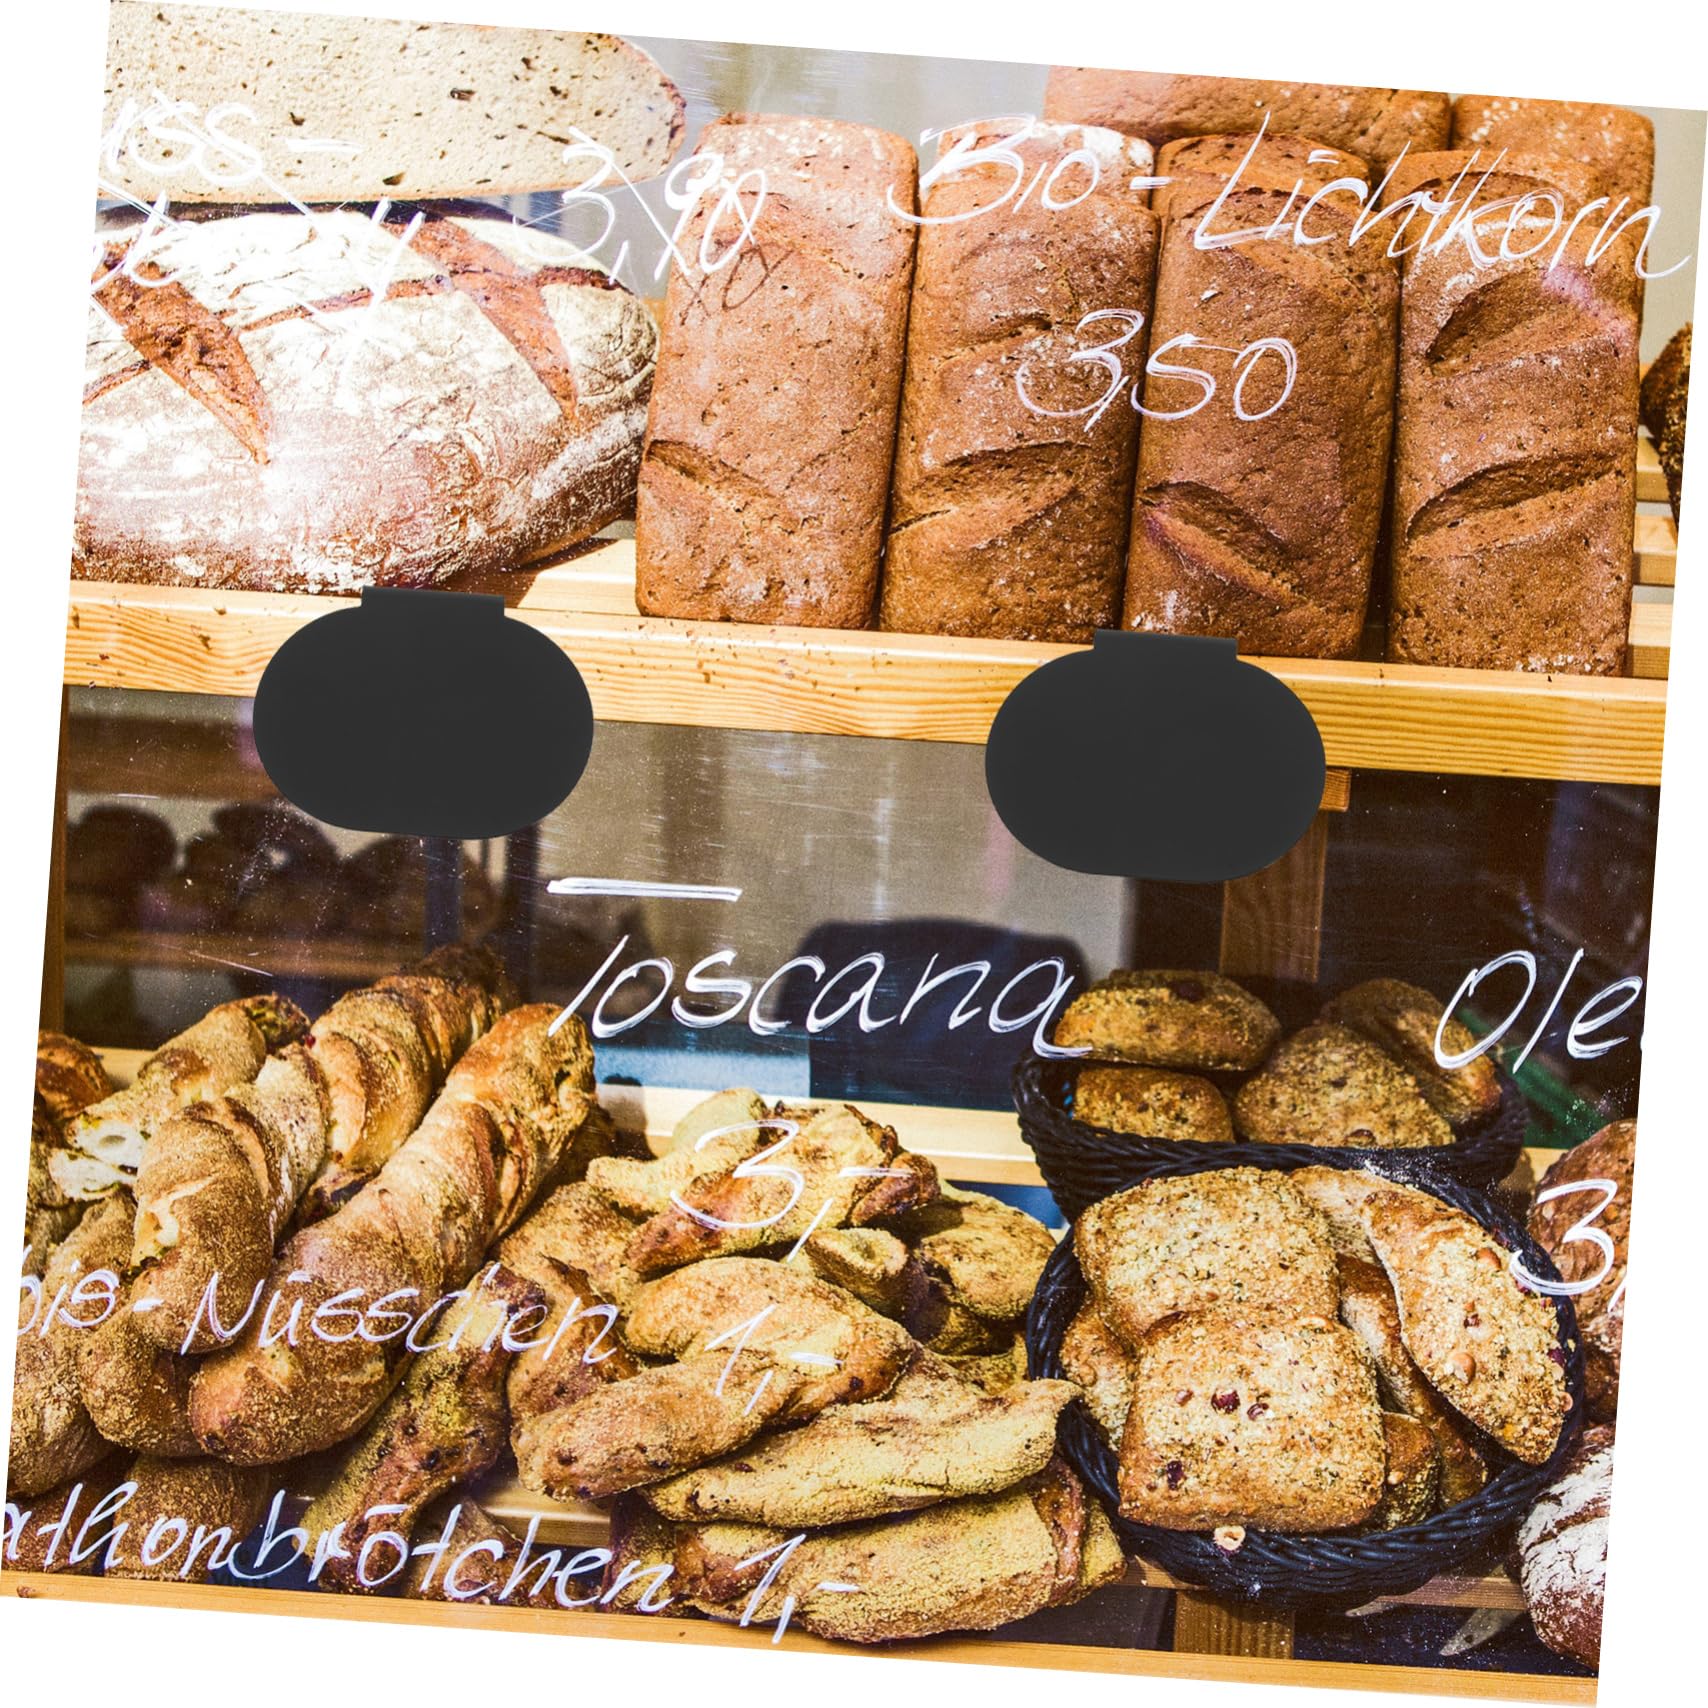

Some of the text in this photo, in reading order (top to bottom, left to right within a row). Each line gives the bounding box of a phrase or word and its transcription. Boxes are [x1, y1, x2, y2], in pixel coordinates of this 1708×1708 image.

[1016, 308, 1299, 432] 3,50
[546, 877, 1092, 1060] Toscana
[1434, 950, 1645, 1075] Ole
